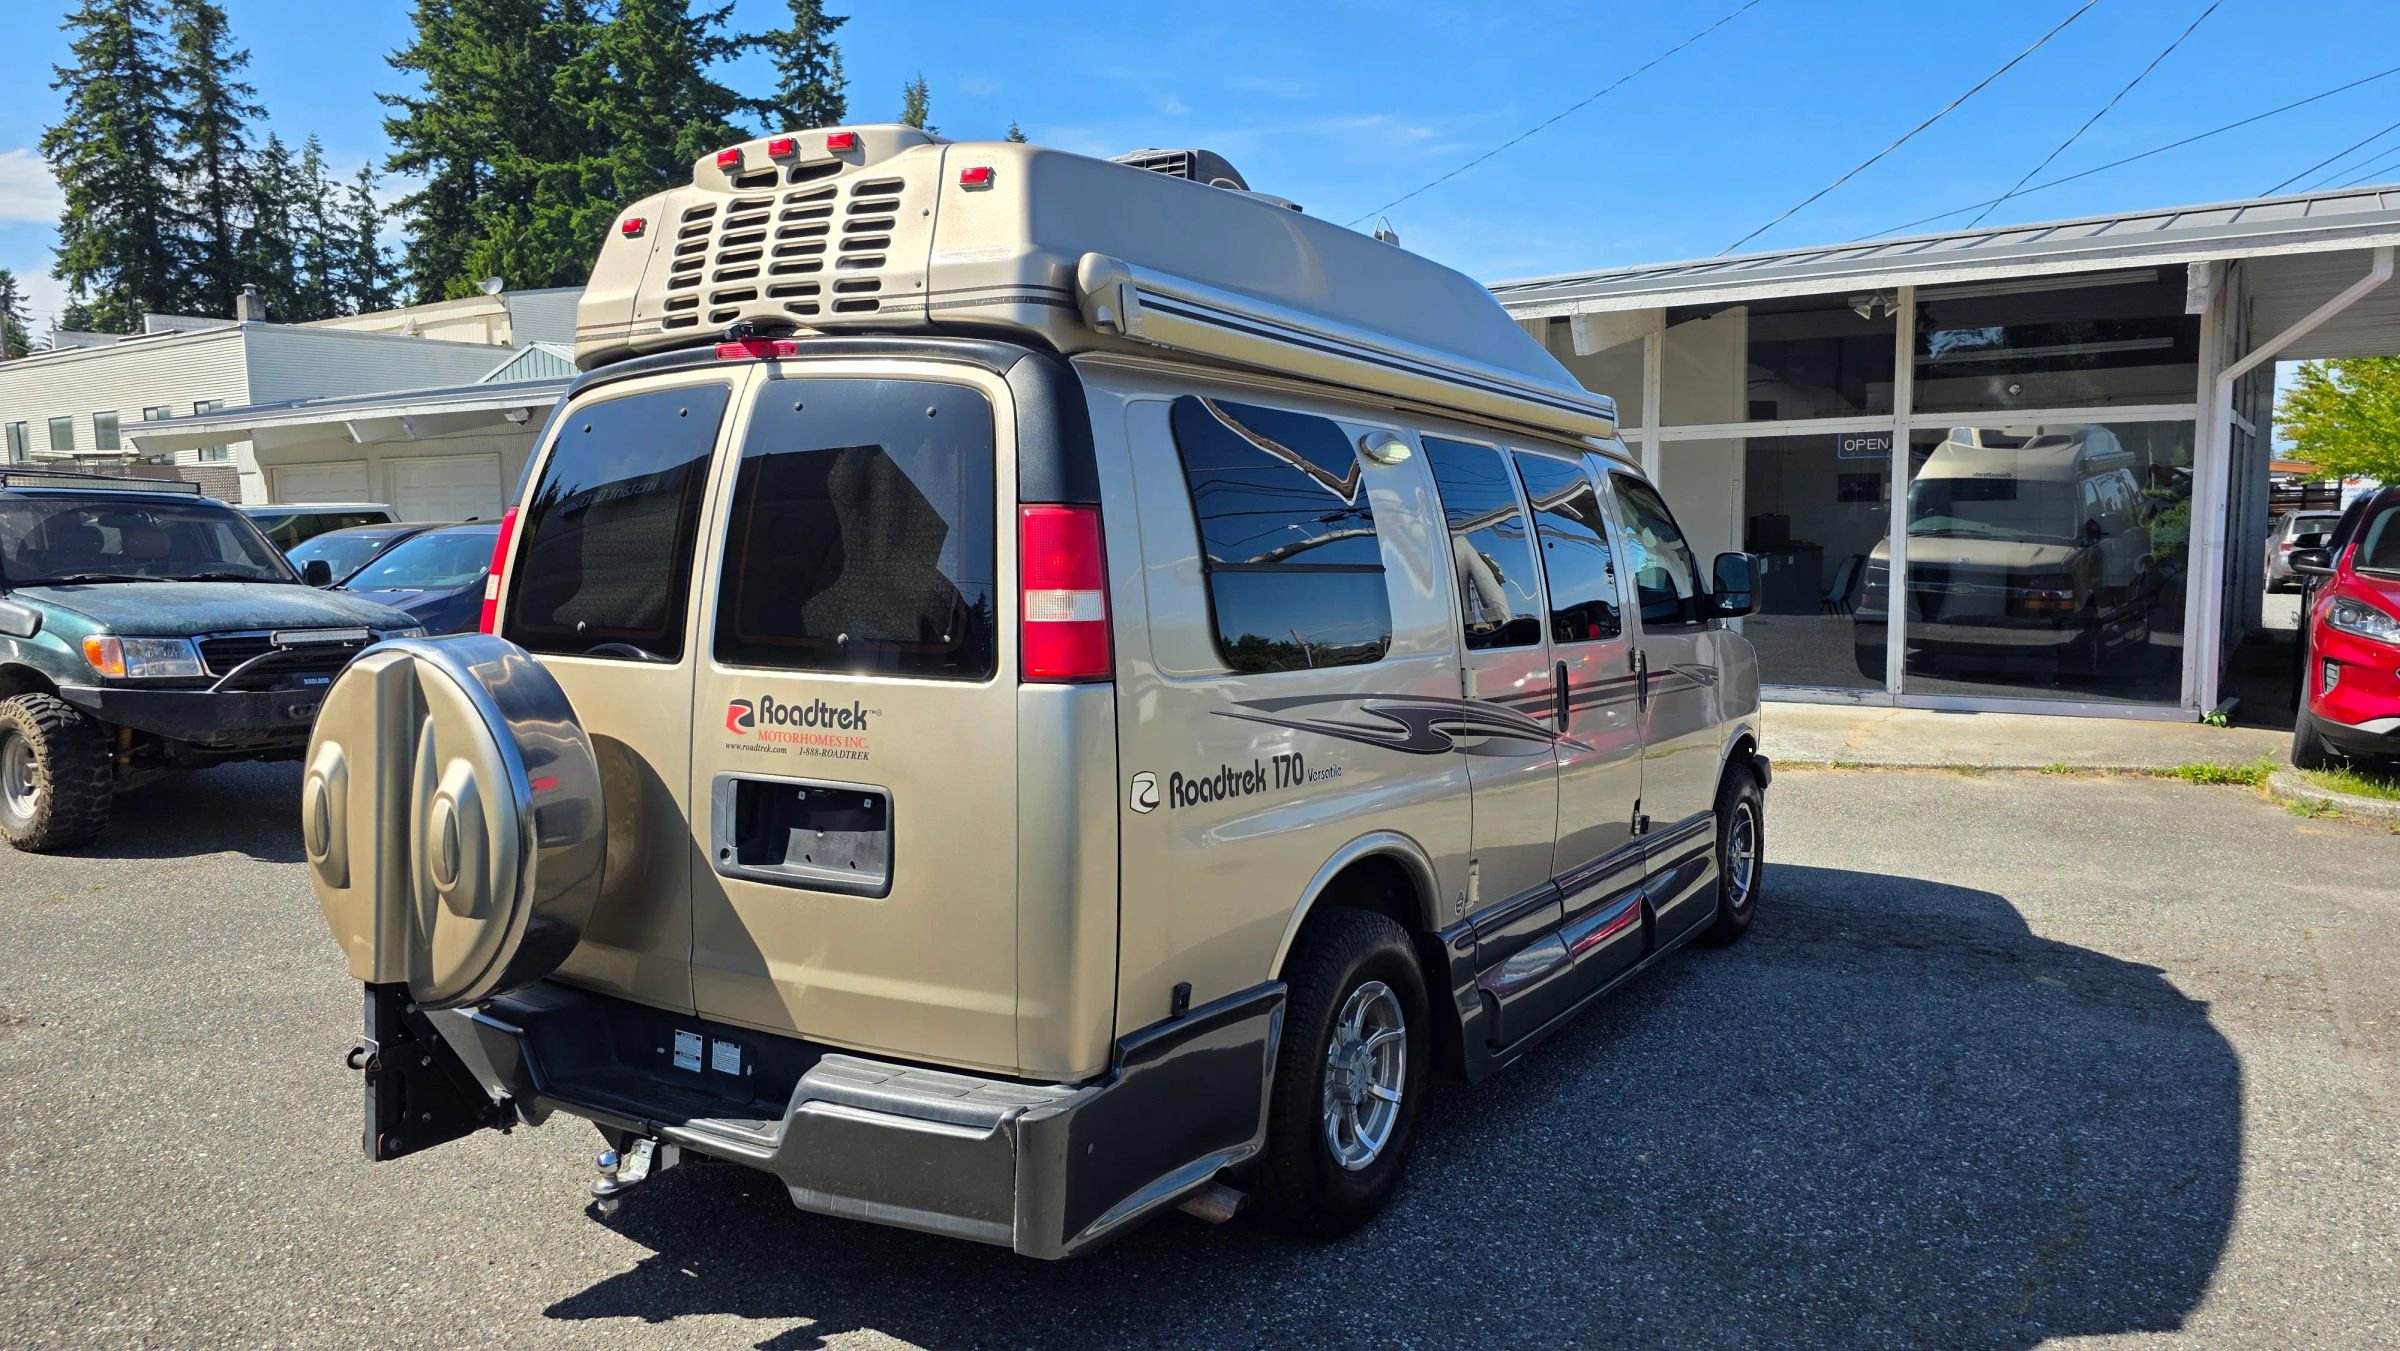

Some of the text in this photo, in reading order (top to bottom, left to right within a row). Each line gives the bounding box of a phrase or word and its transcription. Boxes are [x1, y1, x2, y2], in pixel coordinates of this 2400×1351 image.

[1844, 437, 1889, 451] OPEN
[759, 695, 867, 730] Roadtrek
[758, 730, 870, 749] MOTORHOMES INC.
[725, 742, 870, 760] www.roadtrek.com 1-888-ROADTREK
[1169, 752, 1342, 809] Roadtrek 170 Versatile
